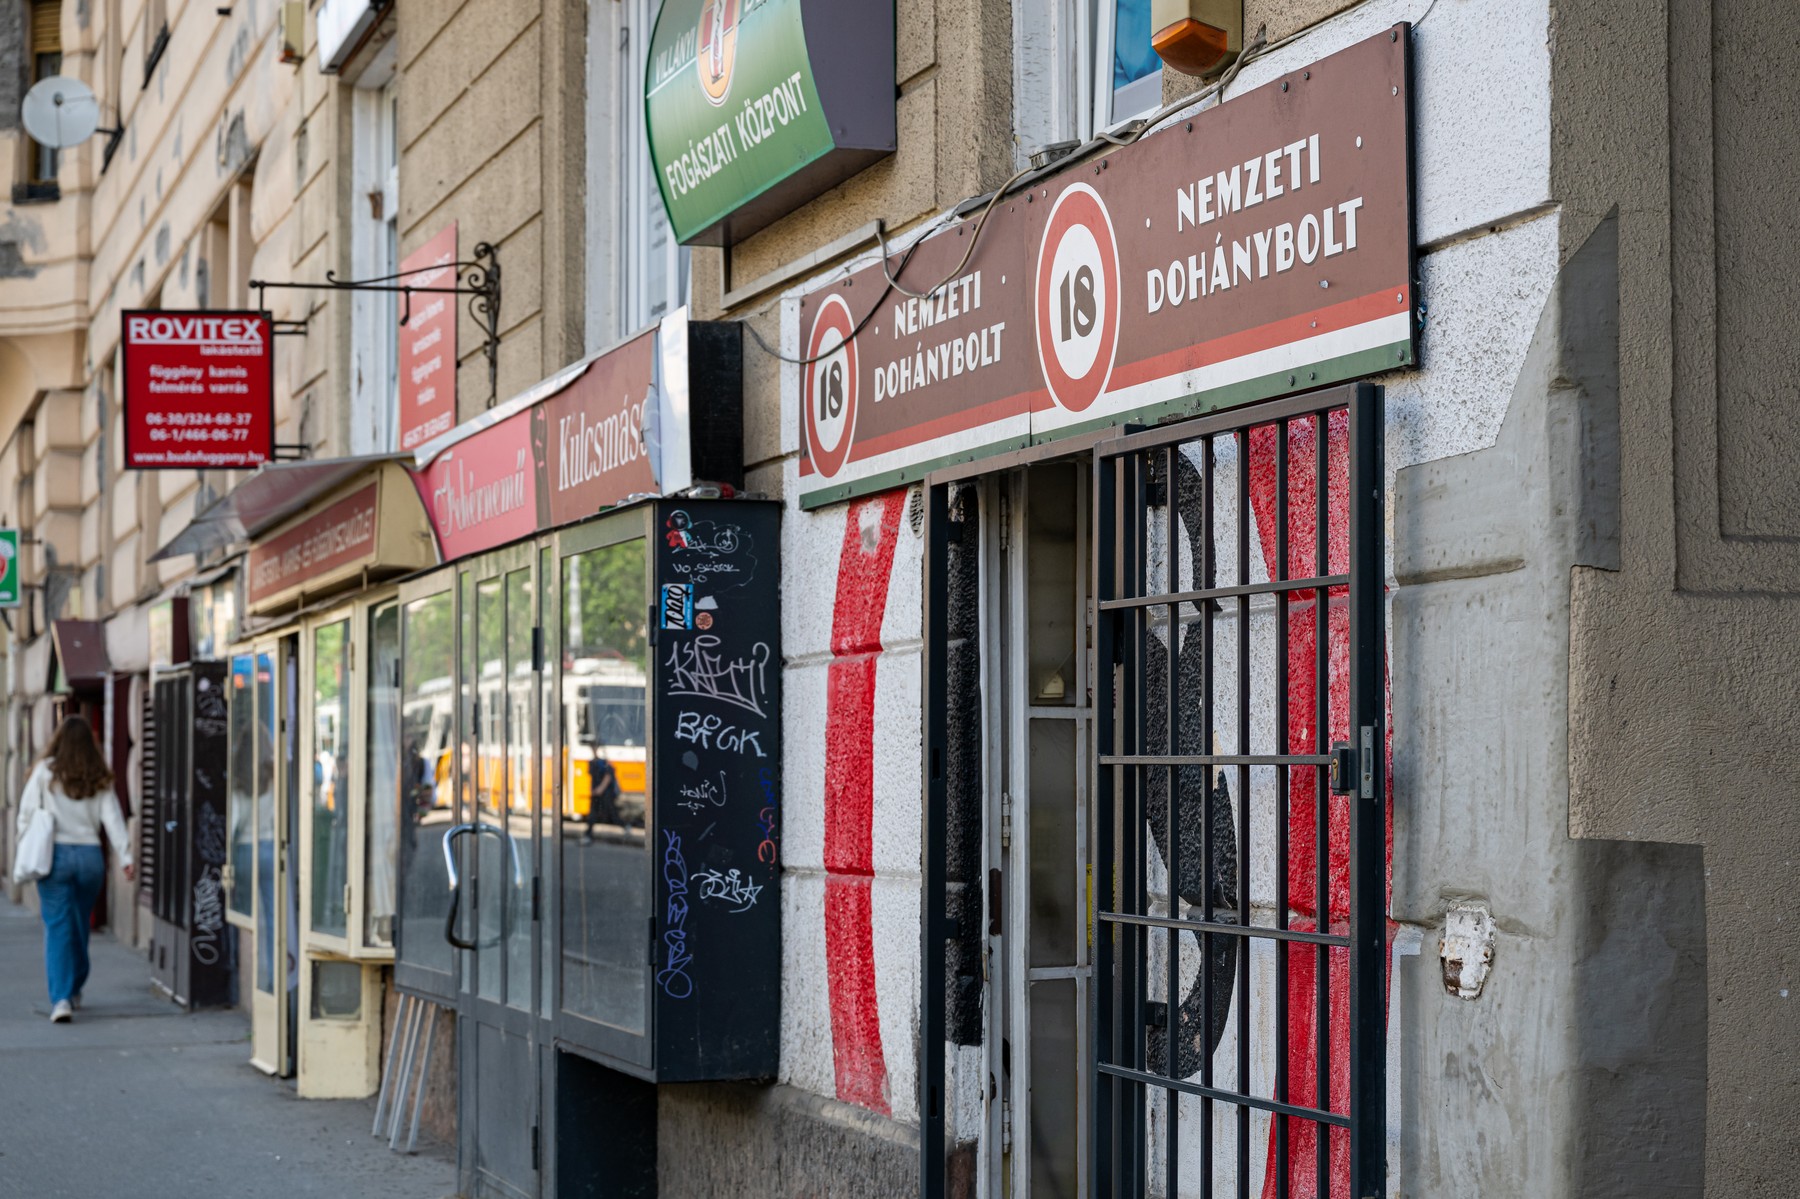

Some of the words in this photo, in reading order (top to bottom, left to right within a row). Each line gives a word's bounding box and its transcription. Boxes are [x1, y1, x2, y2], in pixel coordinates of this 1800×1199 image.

[665, 123, 738, 200] FOGÁSZATI
[734, 71, 807, 151] KÖZPONT
[1177, 133, 1322, 232] NEMZETI
[1146, 196, 1363, 313] DOHÁNYBOLT
[129, 317, 263, 341] ROVITEX
[893, 270, 982, 340] NEMZETI
[1060, 264, 1098, 342] 18
[149, 364, 204, 380] függöny
[208, 364, 248, 378] karnis
[149, 380, 204, 394] felmérés
[208, 381, 249, 394] varrás
[819, 360, 843, 422] 18
[873, 321, 1006, 403] DOHÁNYBOLT
